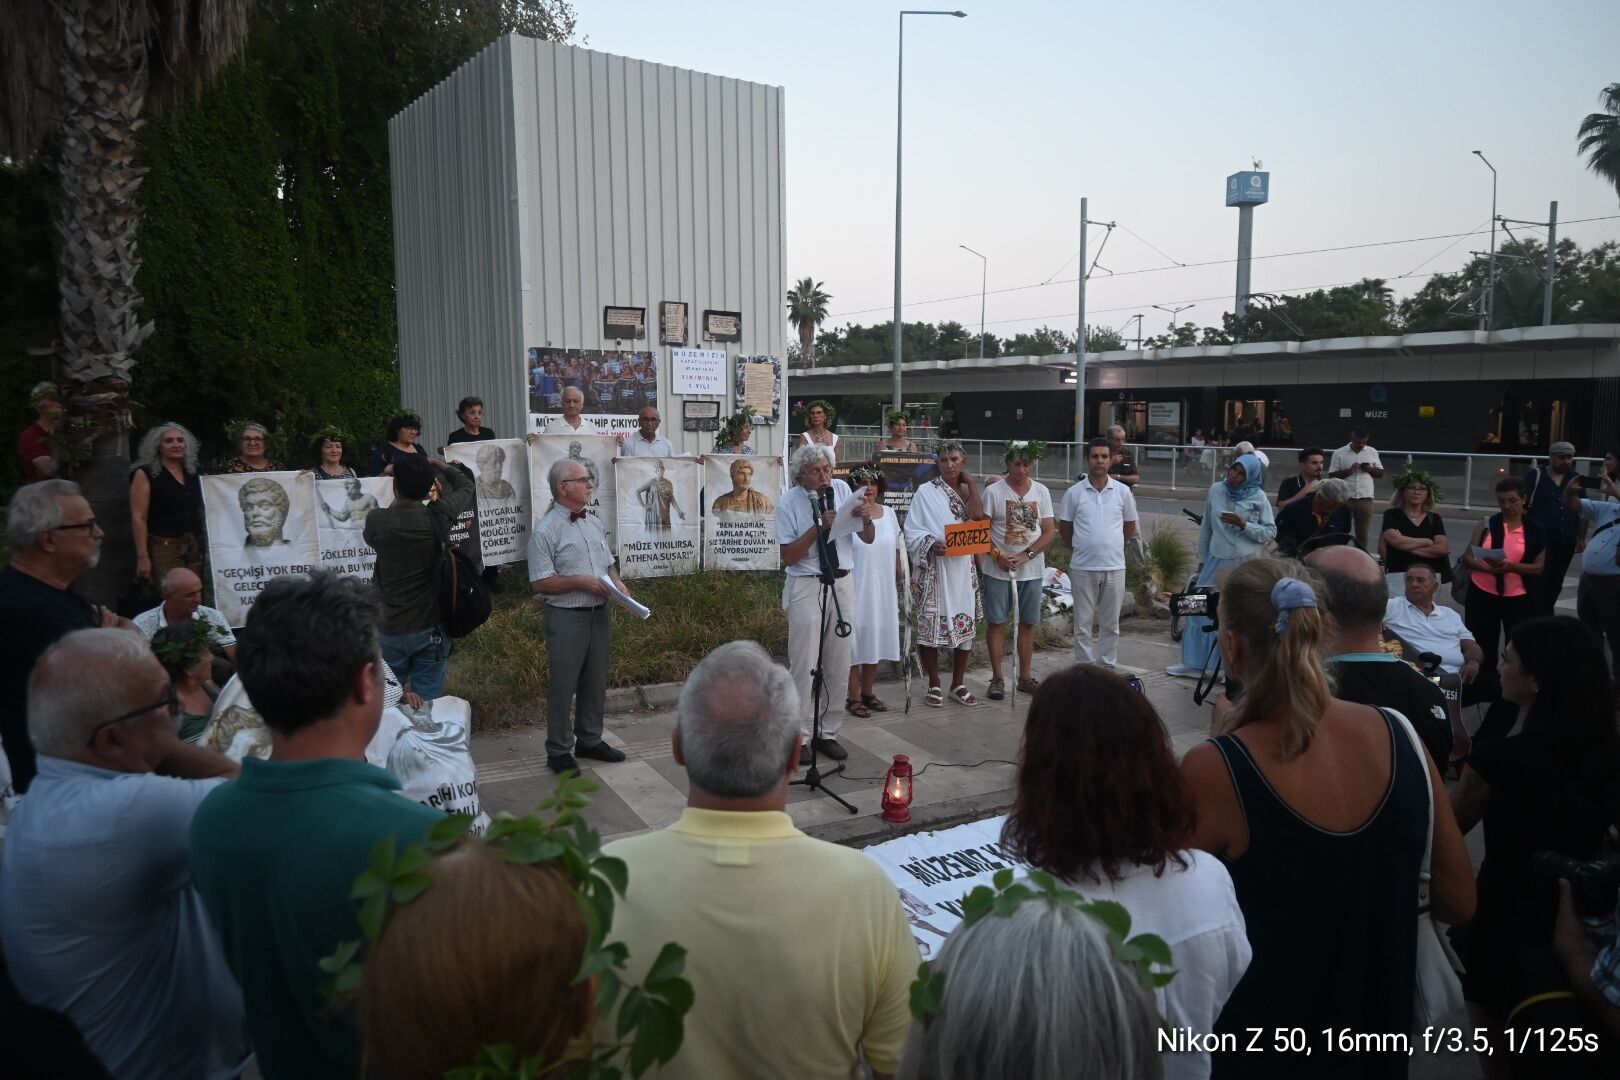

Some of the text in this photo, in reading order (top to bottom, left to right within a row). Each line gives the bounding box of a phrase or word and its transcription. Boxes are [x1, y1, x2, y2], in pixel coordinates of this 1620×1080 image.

[1364, 409, 1389, 418] MÜZE
[511, 524, 526, 534] GÜN
[624, 540, 694, 552] "MÜZE YIKILIRSA,
[626, 553, 659, 563] ATHENA
[217, 565, 264, 580] "GEÇMİŞİ
[265, 566, 288, 576] YOK
[348, 564, 360, 573] BU
